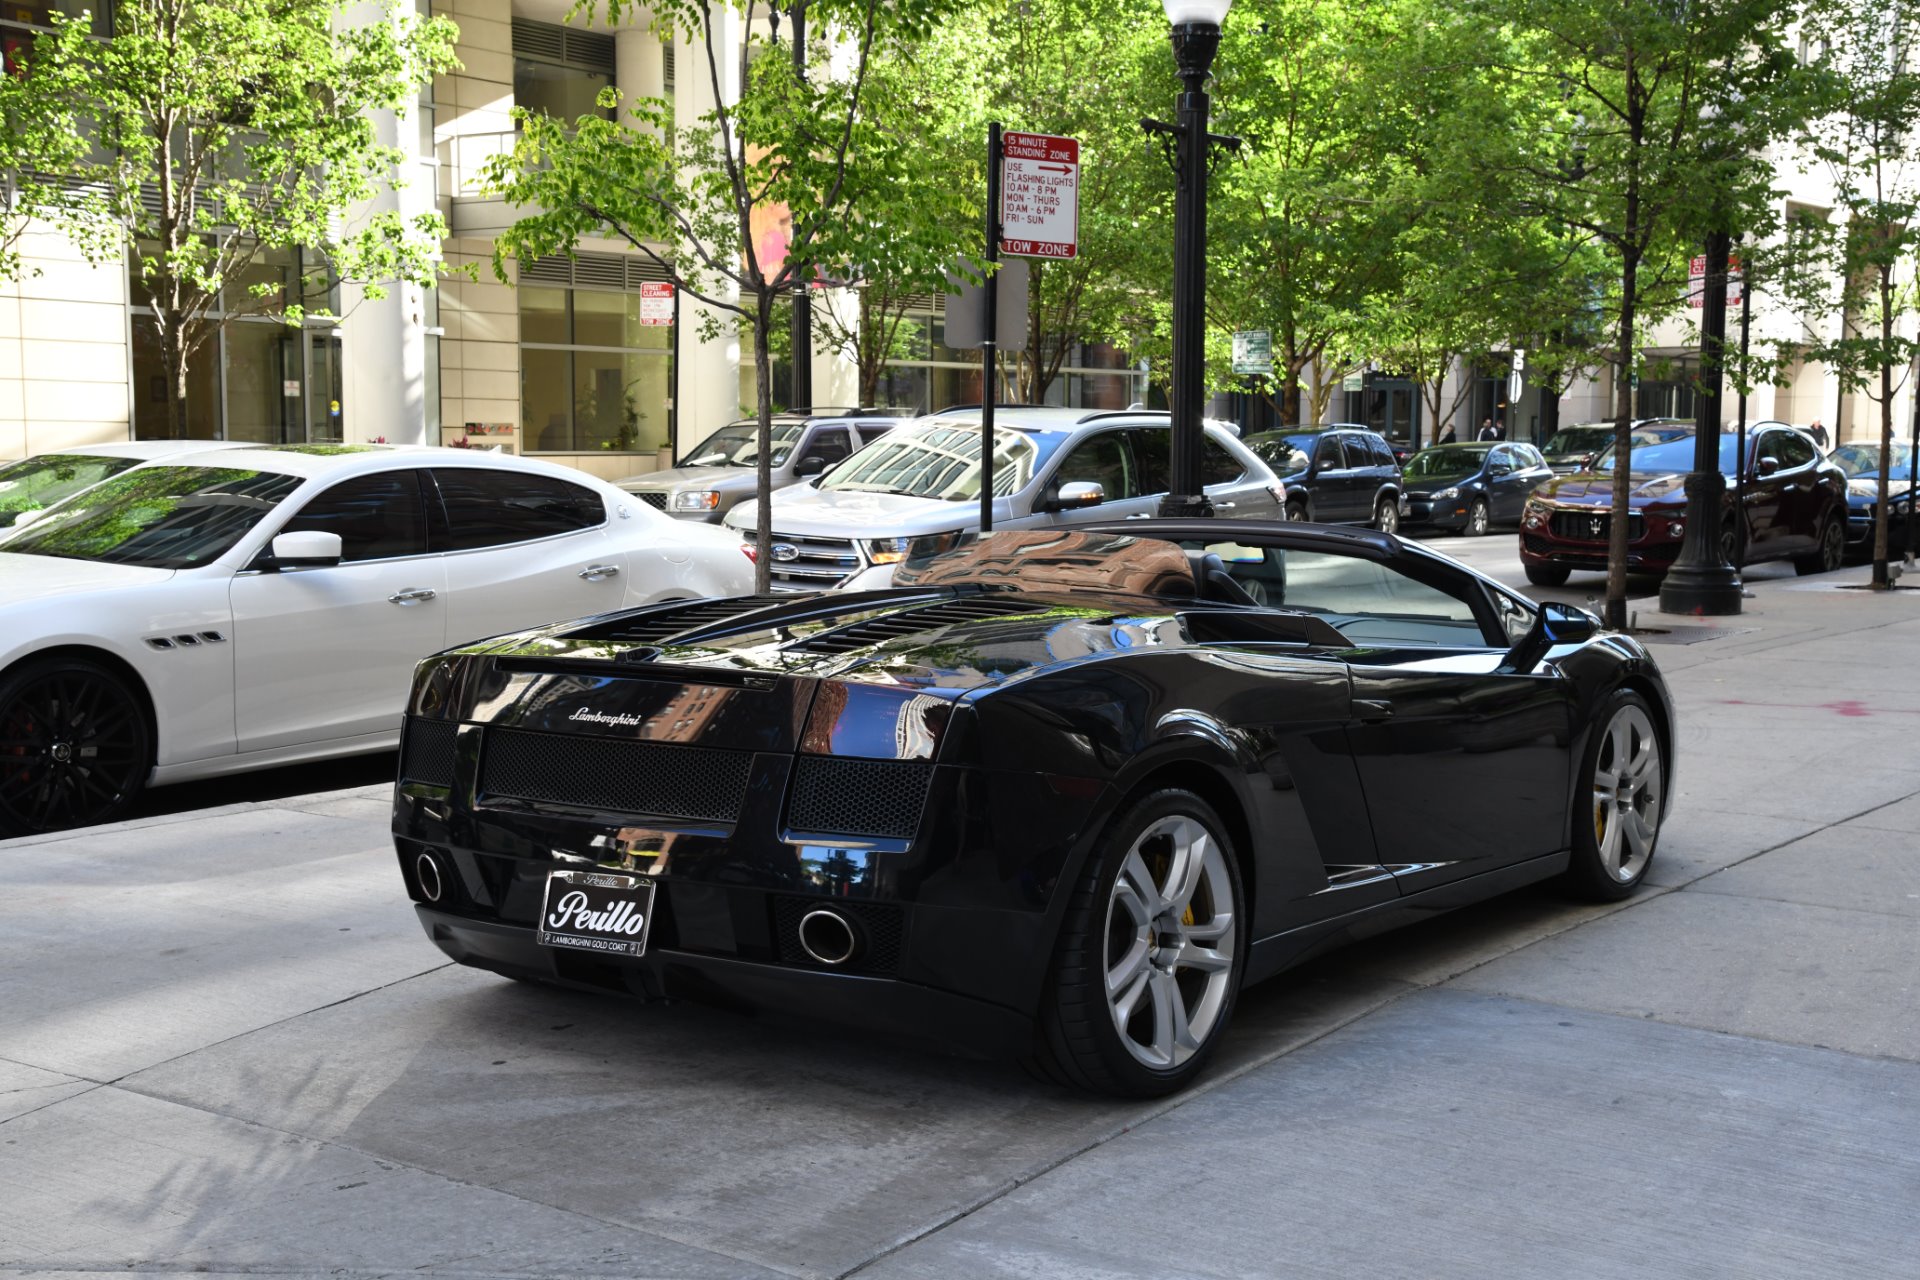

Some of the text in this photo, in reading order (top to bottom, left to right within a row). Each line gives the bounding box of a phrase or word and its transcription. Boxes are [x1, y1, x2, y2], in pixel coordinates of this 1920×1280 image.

[1008, 136, 1048, 148] 15 MINUTE
[1008, 146, 1070, 160] STANDING ZONE
[1007, 163, 1023, 172] USE
[1007, 173, 1074, 187] FLASHING LIGHTS
[1045, 186, 1057, 195] PM
[1006, 193, 1024, 202] MON
[1033, 195, 1060, 206] THURS
[1044, 207, 1055, 215] PM
[1006, 213, 1019, 222] FRI
[1027, 216, 1044, 224] SUN
[1006, 241, 1069, 256] TOW ZONE
[568, 707, 642, 727] Lamborghini
[583, 874, 618, 886] Perillo
[549, 890, 644, 935] Perillo
[552, 936, 591, 947] LAMBORGHINI
[608, 942, 627, 951] COAST
